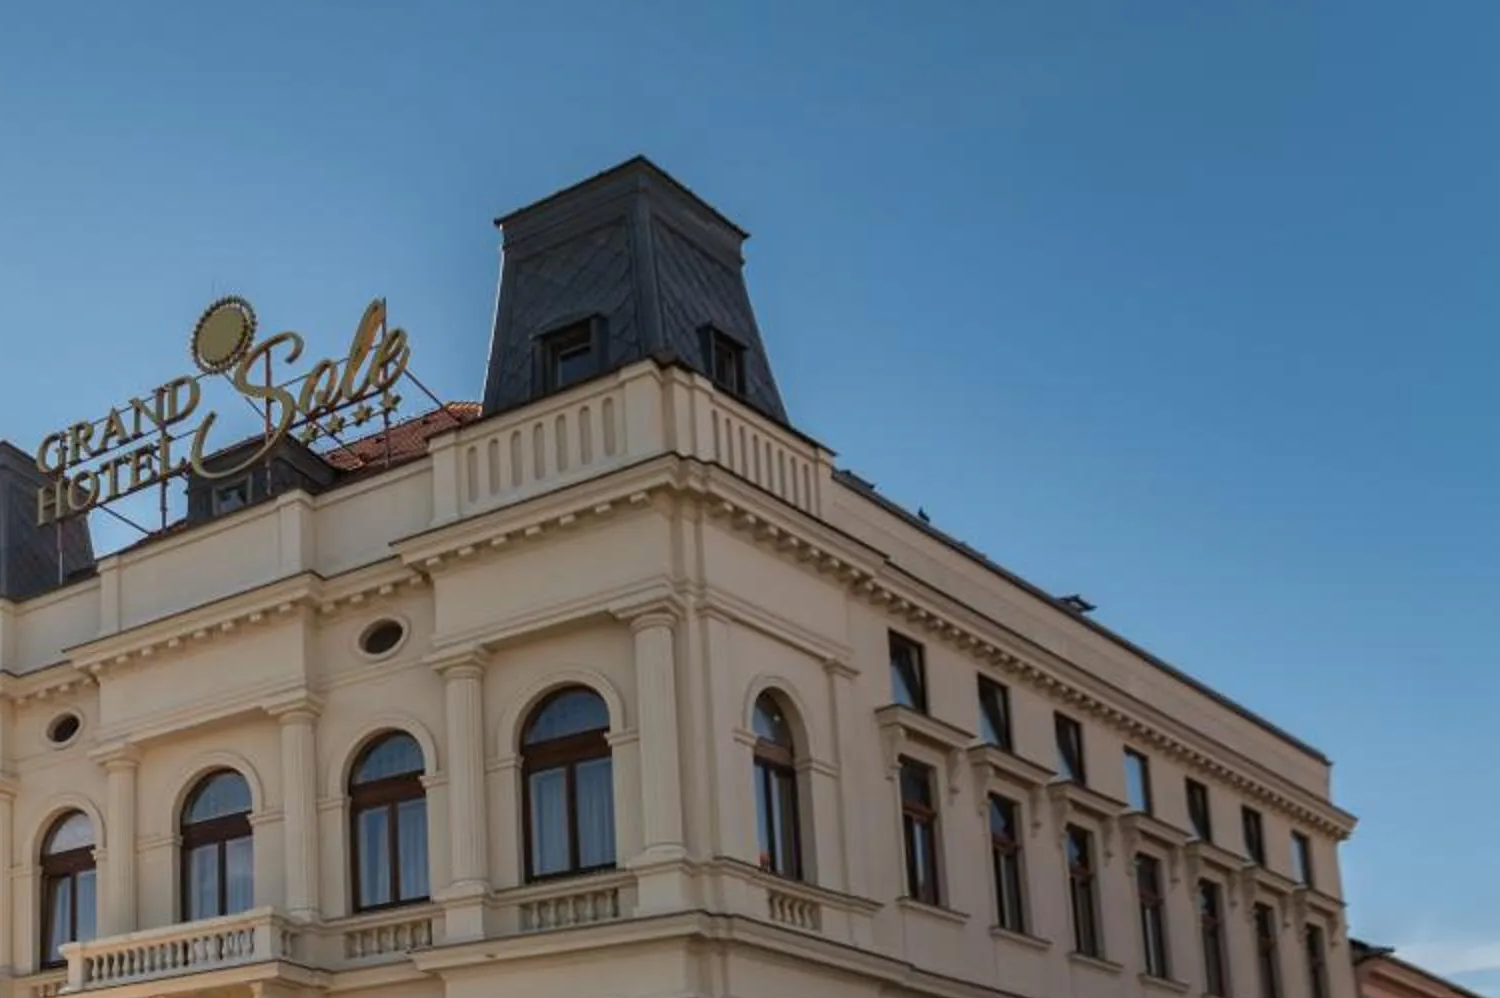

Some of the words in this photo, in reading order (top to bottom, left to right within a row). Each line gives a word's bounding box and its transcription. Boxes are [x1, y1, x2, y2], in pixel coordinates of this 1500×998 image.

[36, 374, 200, 475] GRAND
[191, 299, 410, 479] Sole
[35, 434, 192, 526] HOTEL
